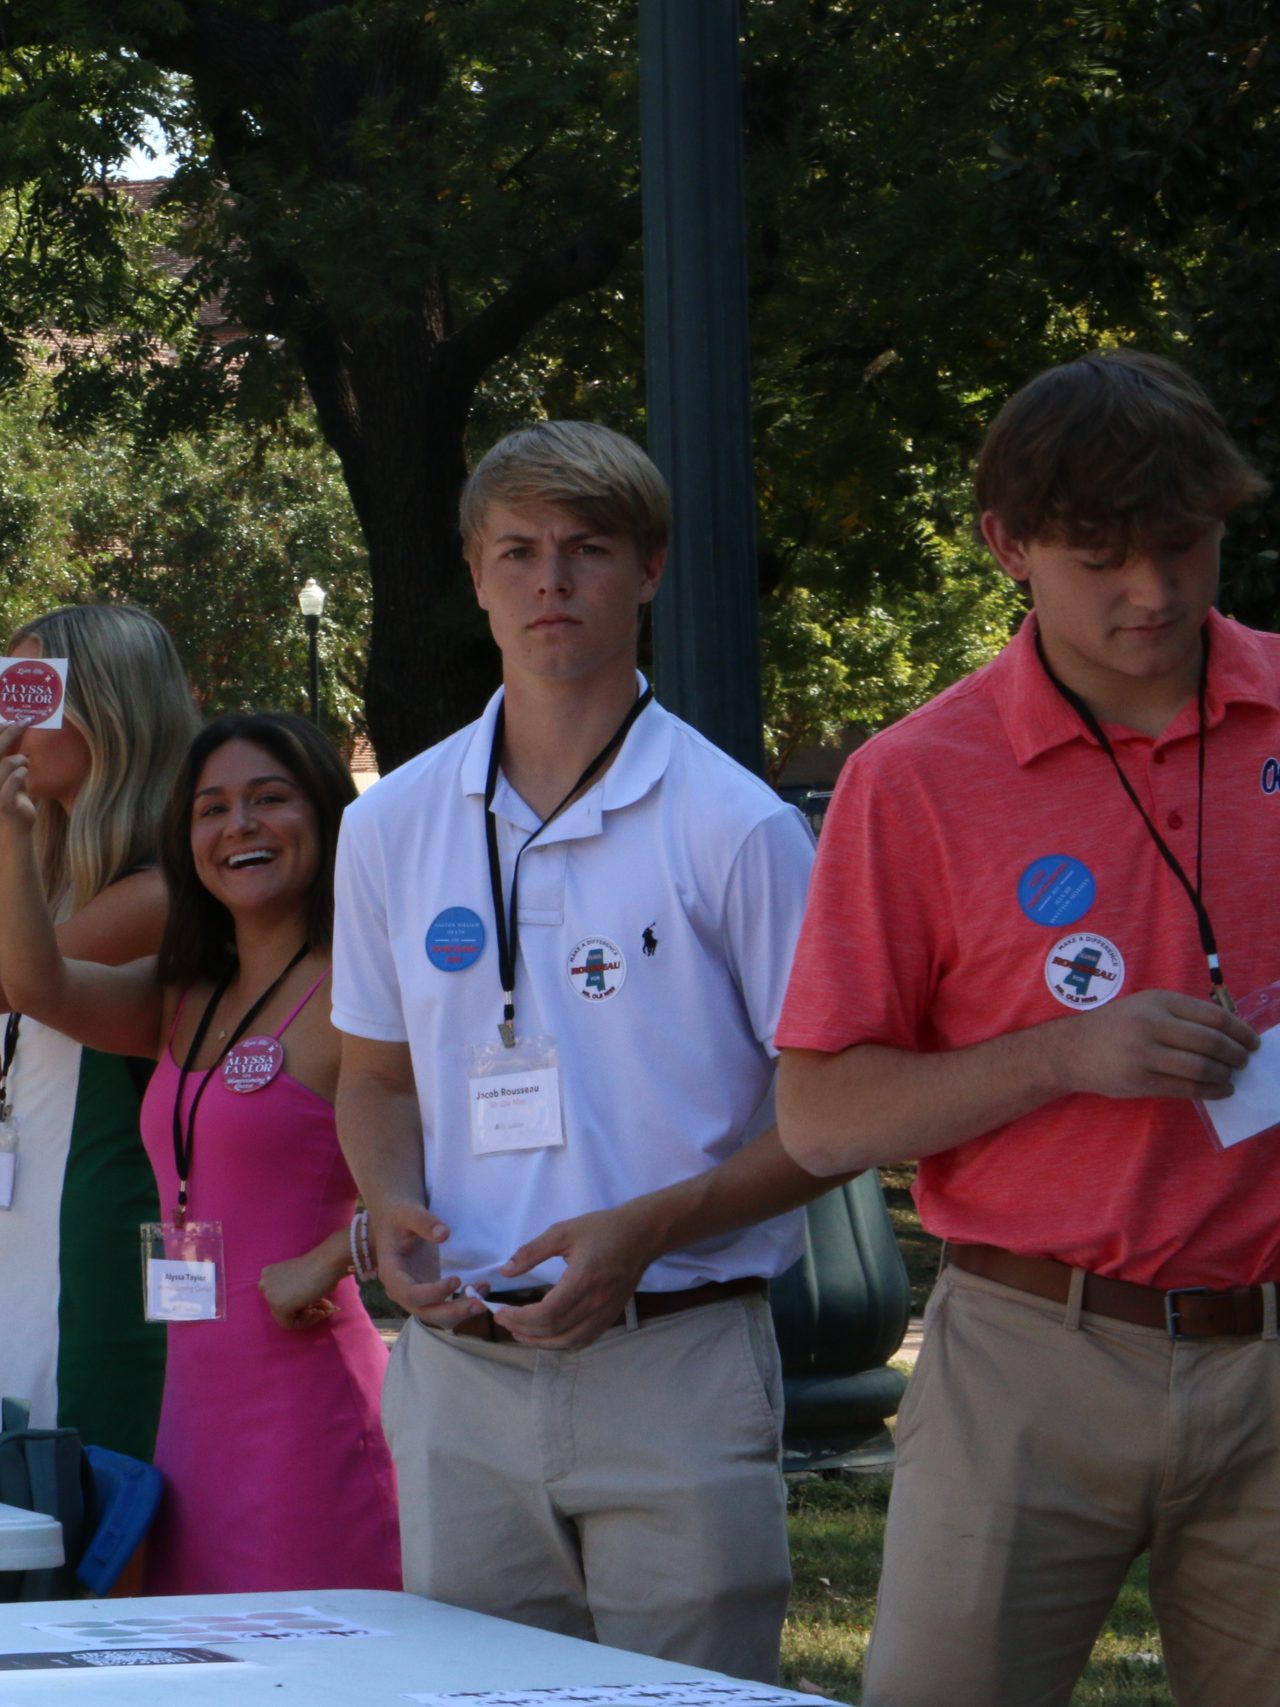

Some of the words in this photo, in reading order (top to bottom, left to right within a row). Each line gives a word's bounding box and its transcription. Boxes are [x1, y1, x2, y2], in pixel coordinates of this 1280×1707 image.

[1, 684, 53, 695] ALYSSA
[0, 692, 53, 704] TAYLOR
[227, 1055, 274, 1066] ALYSSA
[476, 1088, 499, 1100] Jacob
[500, 1085, 540, 1097] Rousseau
